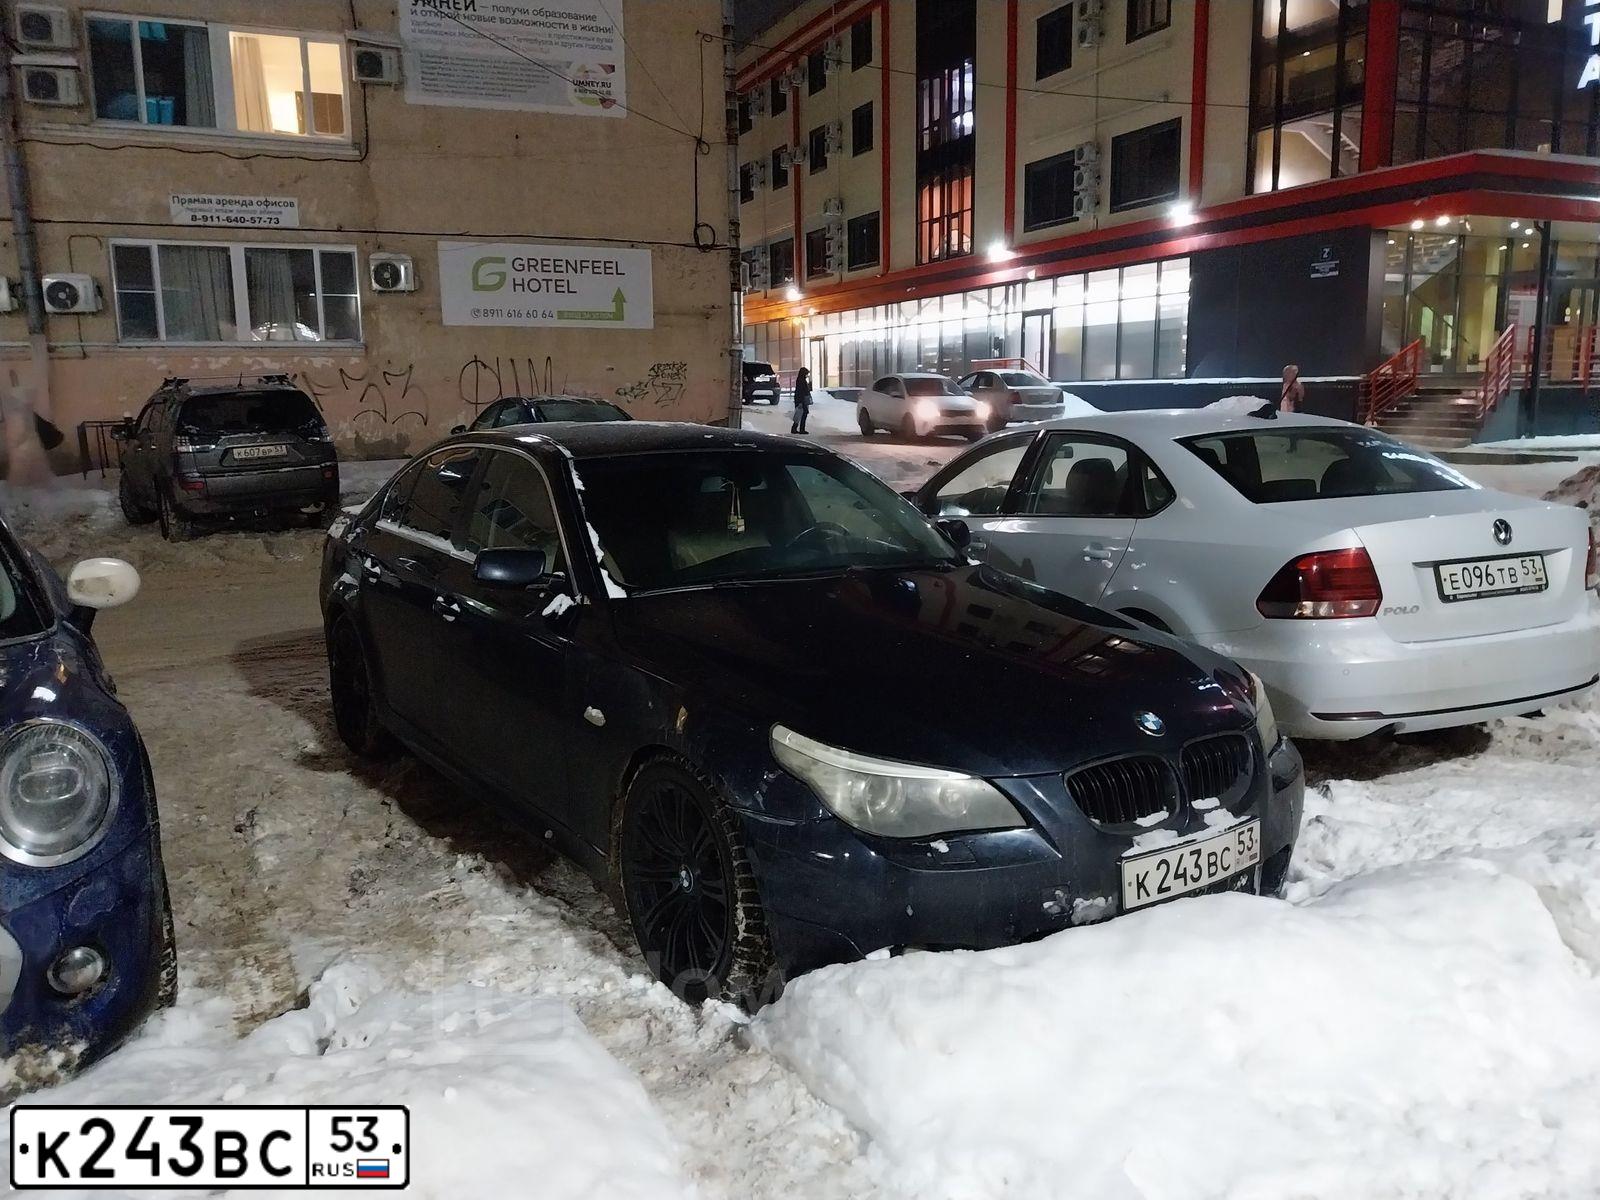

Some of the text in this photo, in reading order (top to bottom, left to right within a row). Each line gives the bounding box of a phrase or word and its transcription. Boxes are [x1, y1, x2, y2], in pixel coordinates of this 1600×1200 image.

[492, 4, 529, 17] получи
[532, 8, 597, 22] образование
[463, 14, 497, 24] новые
[499, 16, 570, 30] возможности
[580, 24, 614, 35] жизни!
[172, 195, 295, 209] Прямая аренда офисов
[190, 214, 280, 225] 8-911-640-57-73
[512, 257, 626, 276] GREENFEEL
[512, 277, 578, 294] HOTEL
[507, 310, 522, 319] 616
[525, 310, 539, 320] 60
[541, 310, 554, 320] 64
[1520, 558, 1538, 576] 53
[1383, 605, 1420, 616] POLO
[1237, 826, 1255, 856] 53
